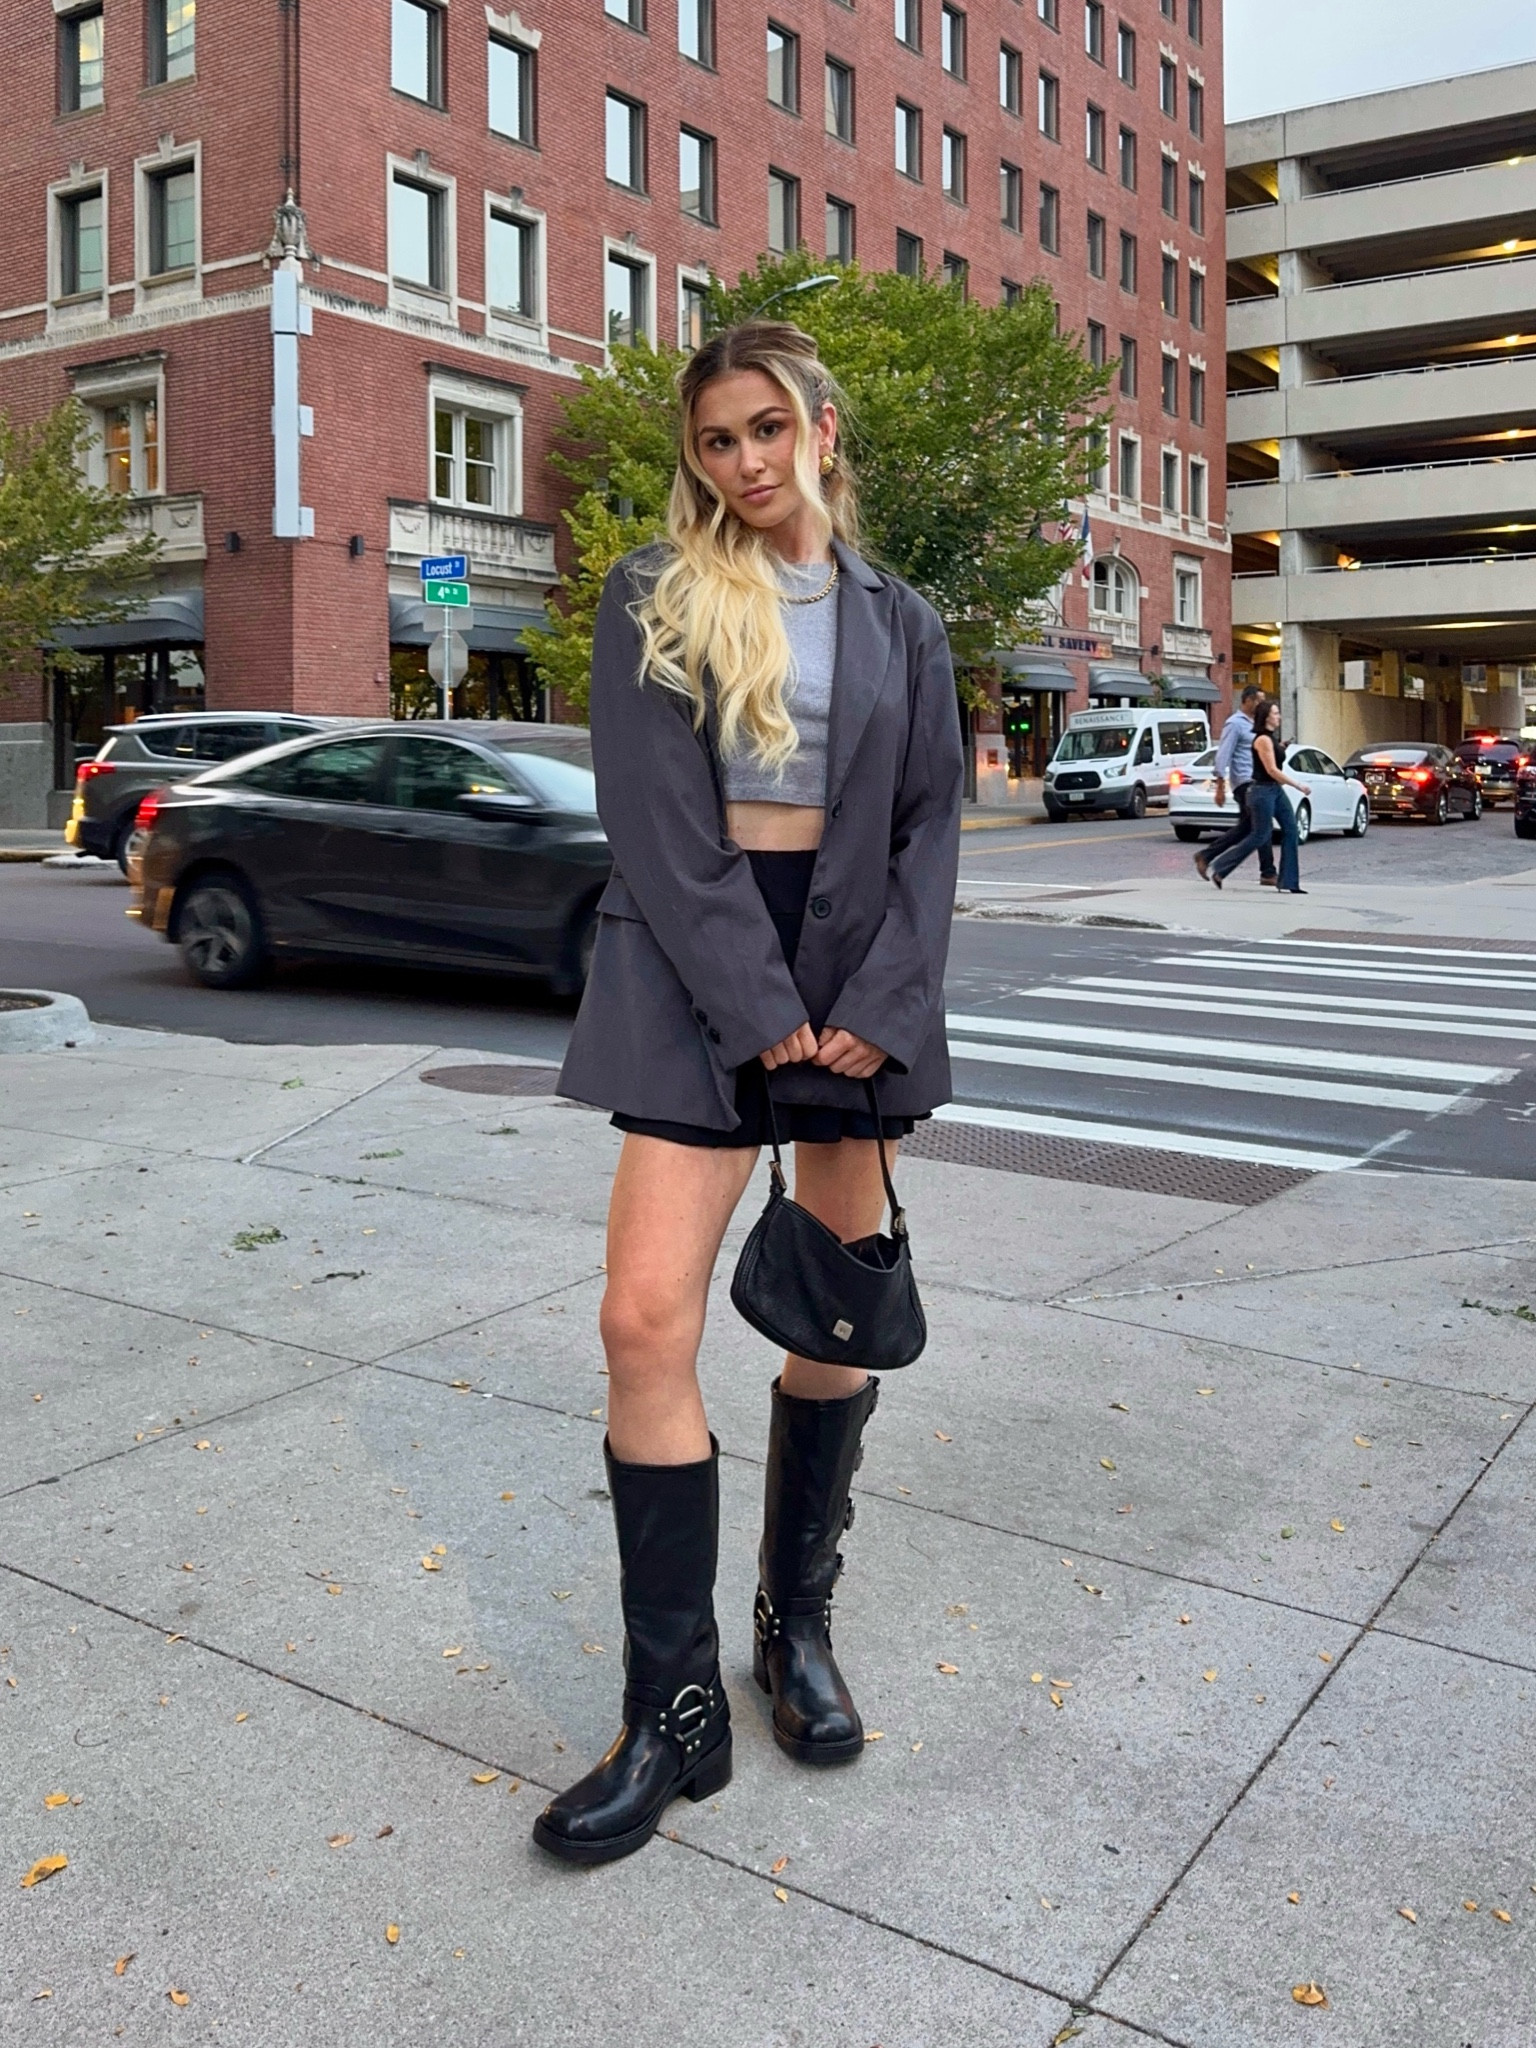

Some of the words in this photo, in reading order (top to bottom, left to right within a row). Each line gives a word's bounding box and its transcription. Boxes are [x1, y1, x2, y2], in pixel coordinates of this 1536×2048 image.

[426, 562, 452, 576] Locust
[1059, 637, 1098, 651] SAVERY
[1074, 714, 1125, 725] RENAISSANCE
